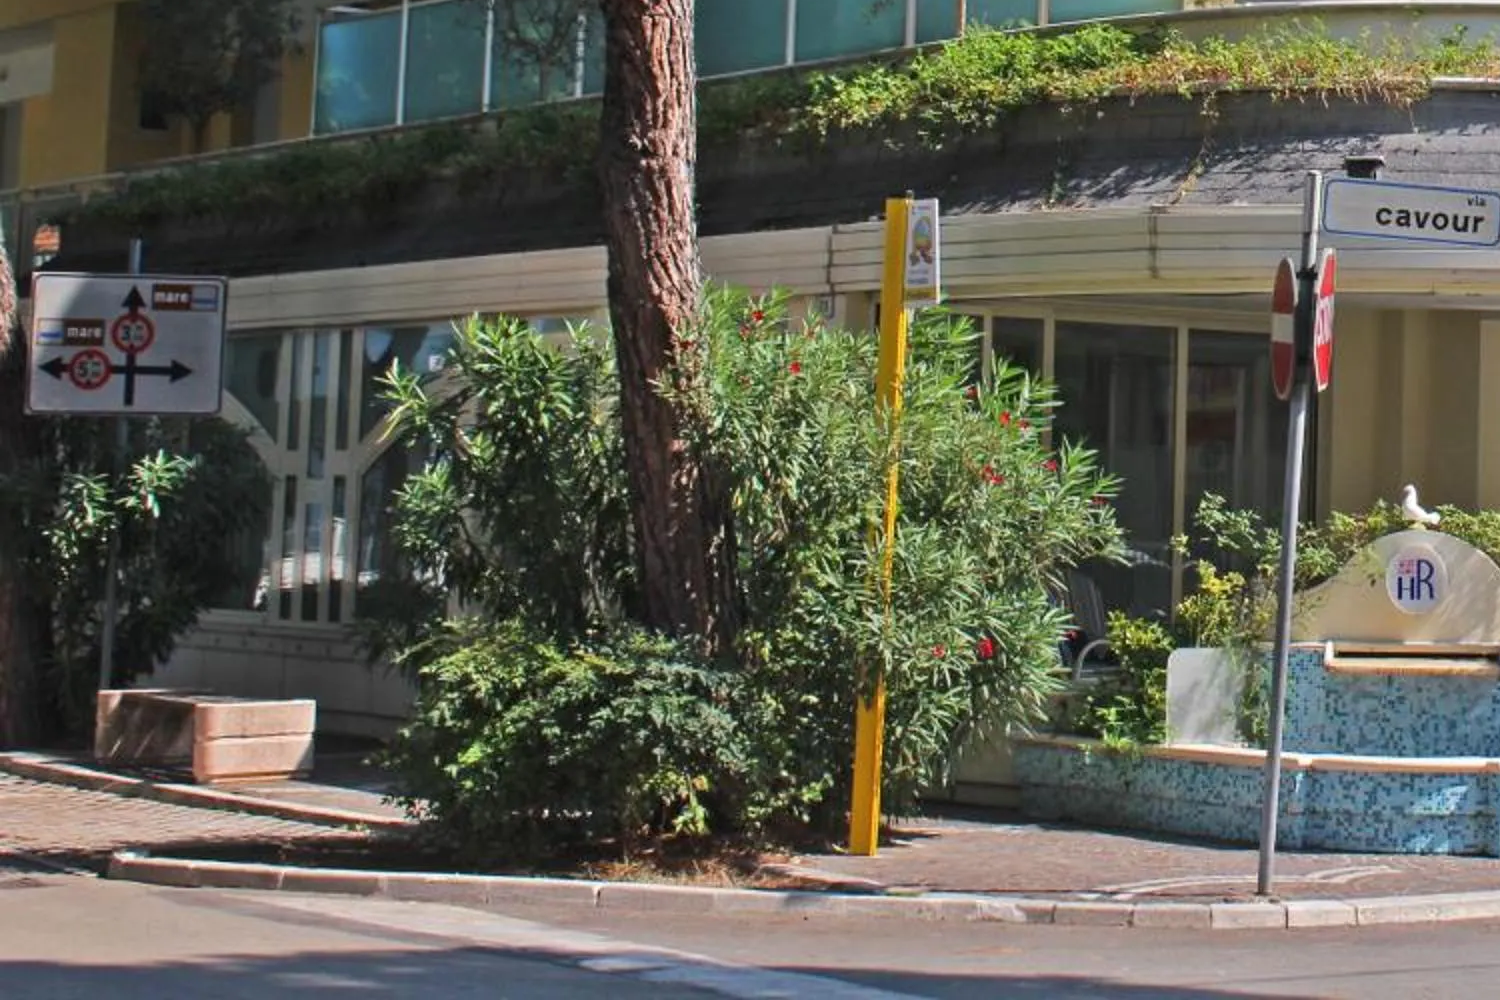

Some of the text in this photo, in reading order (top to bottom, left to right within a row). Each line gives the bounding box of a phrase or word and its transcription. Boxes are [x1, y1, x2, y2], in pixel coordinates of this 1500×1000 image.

[1466, 195, 1487, 208] via
[1375, 206, 1486, 233] cavour
[154, 290, 188, 303] mare
[66, 325, 103, 338] mare
[1397, 559, 1434, 600] HR
